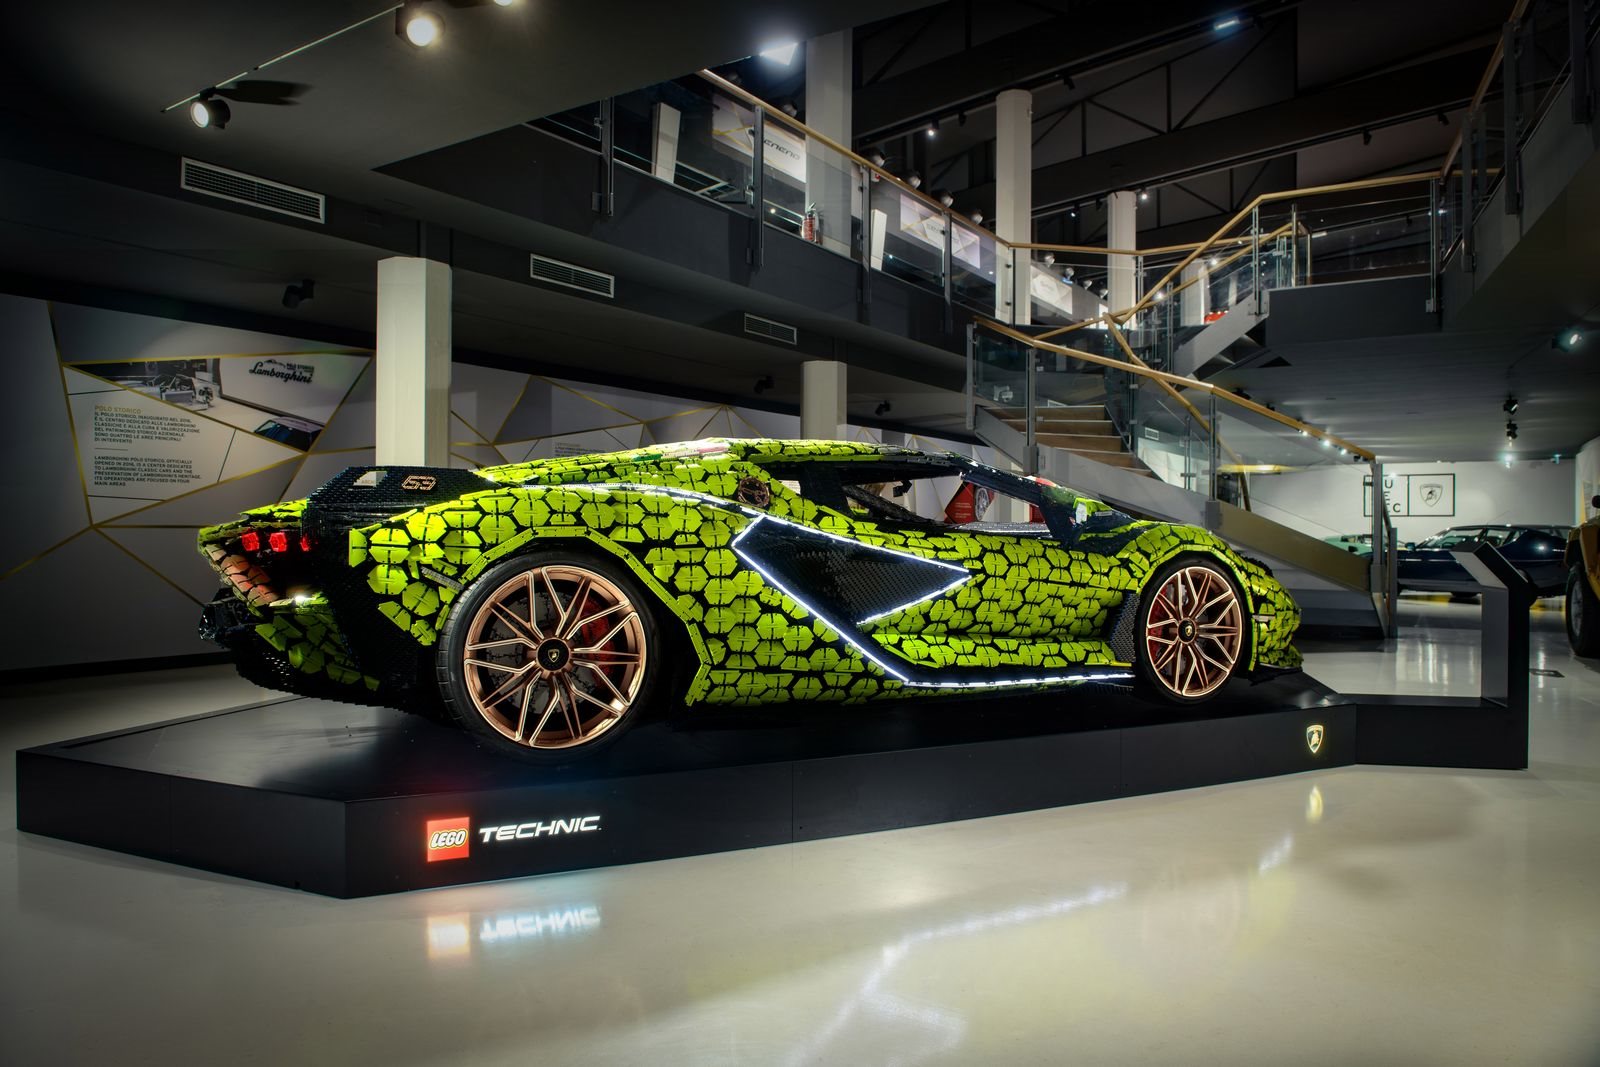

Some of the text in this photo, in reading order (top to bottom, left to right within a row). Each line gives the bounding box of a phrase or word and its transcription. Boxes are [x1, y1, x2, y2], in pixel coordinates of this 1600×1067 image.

[763, 139, 800, 160] ENENO
[249, 362, 313, 384] Lamborghini
[401, 476, 436, 490] 63
[430, 816, 600, 849] LEGO TECHNIC
